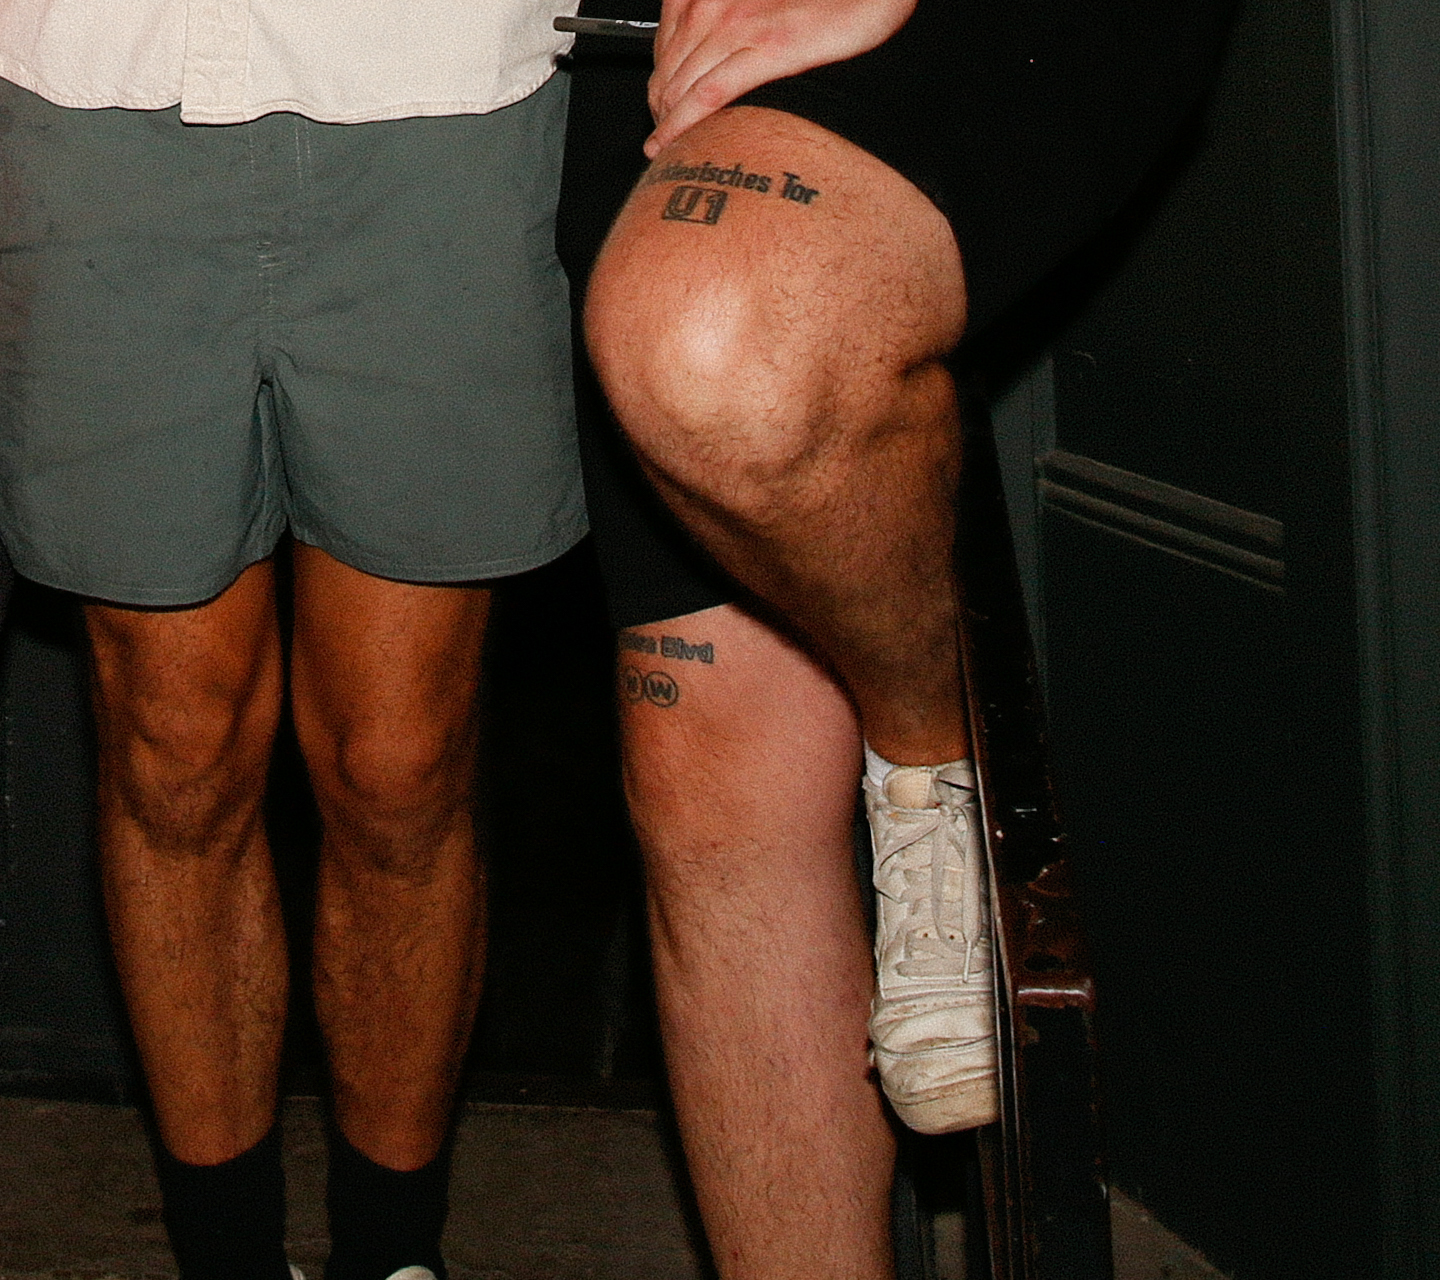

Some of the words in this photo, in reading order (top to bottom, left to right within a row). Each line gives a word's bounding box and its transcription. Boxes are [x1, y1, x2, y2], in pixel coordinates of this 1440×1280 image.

[665, 186, 727, 224] U1
[782, 171, 820, 205] Tor
[661, 635, 714, 664] Blvd
